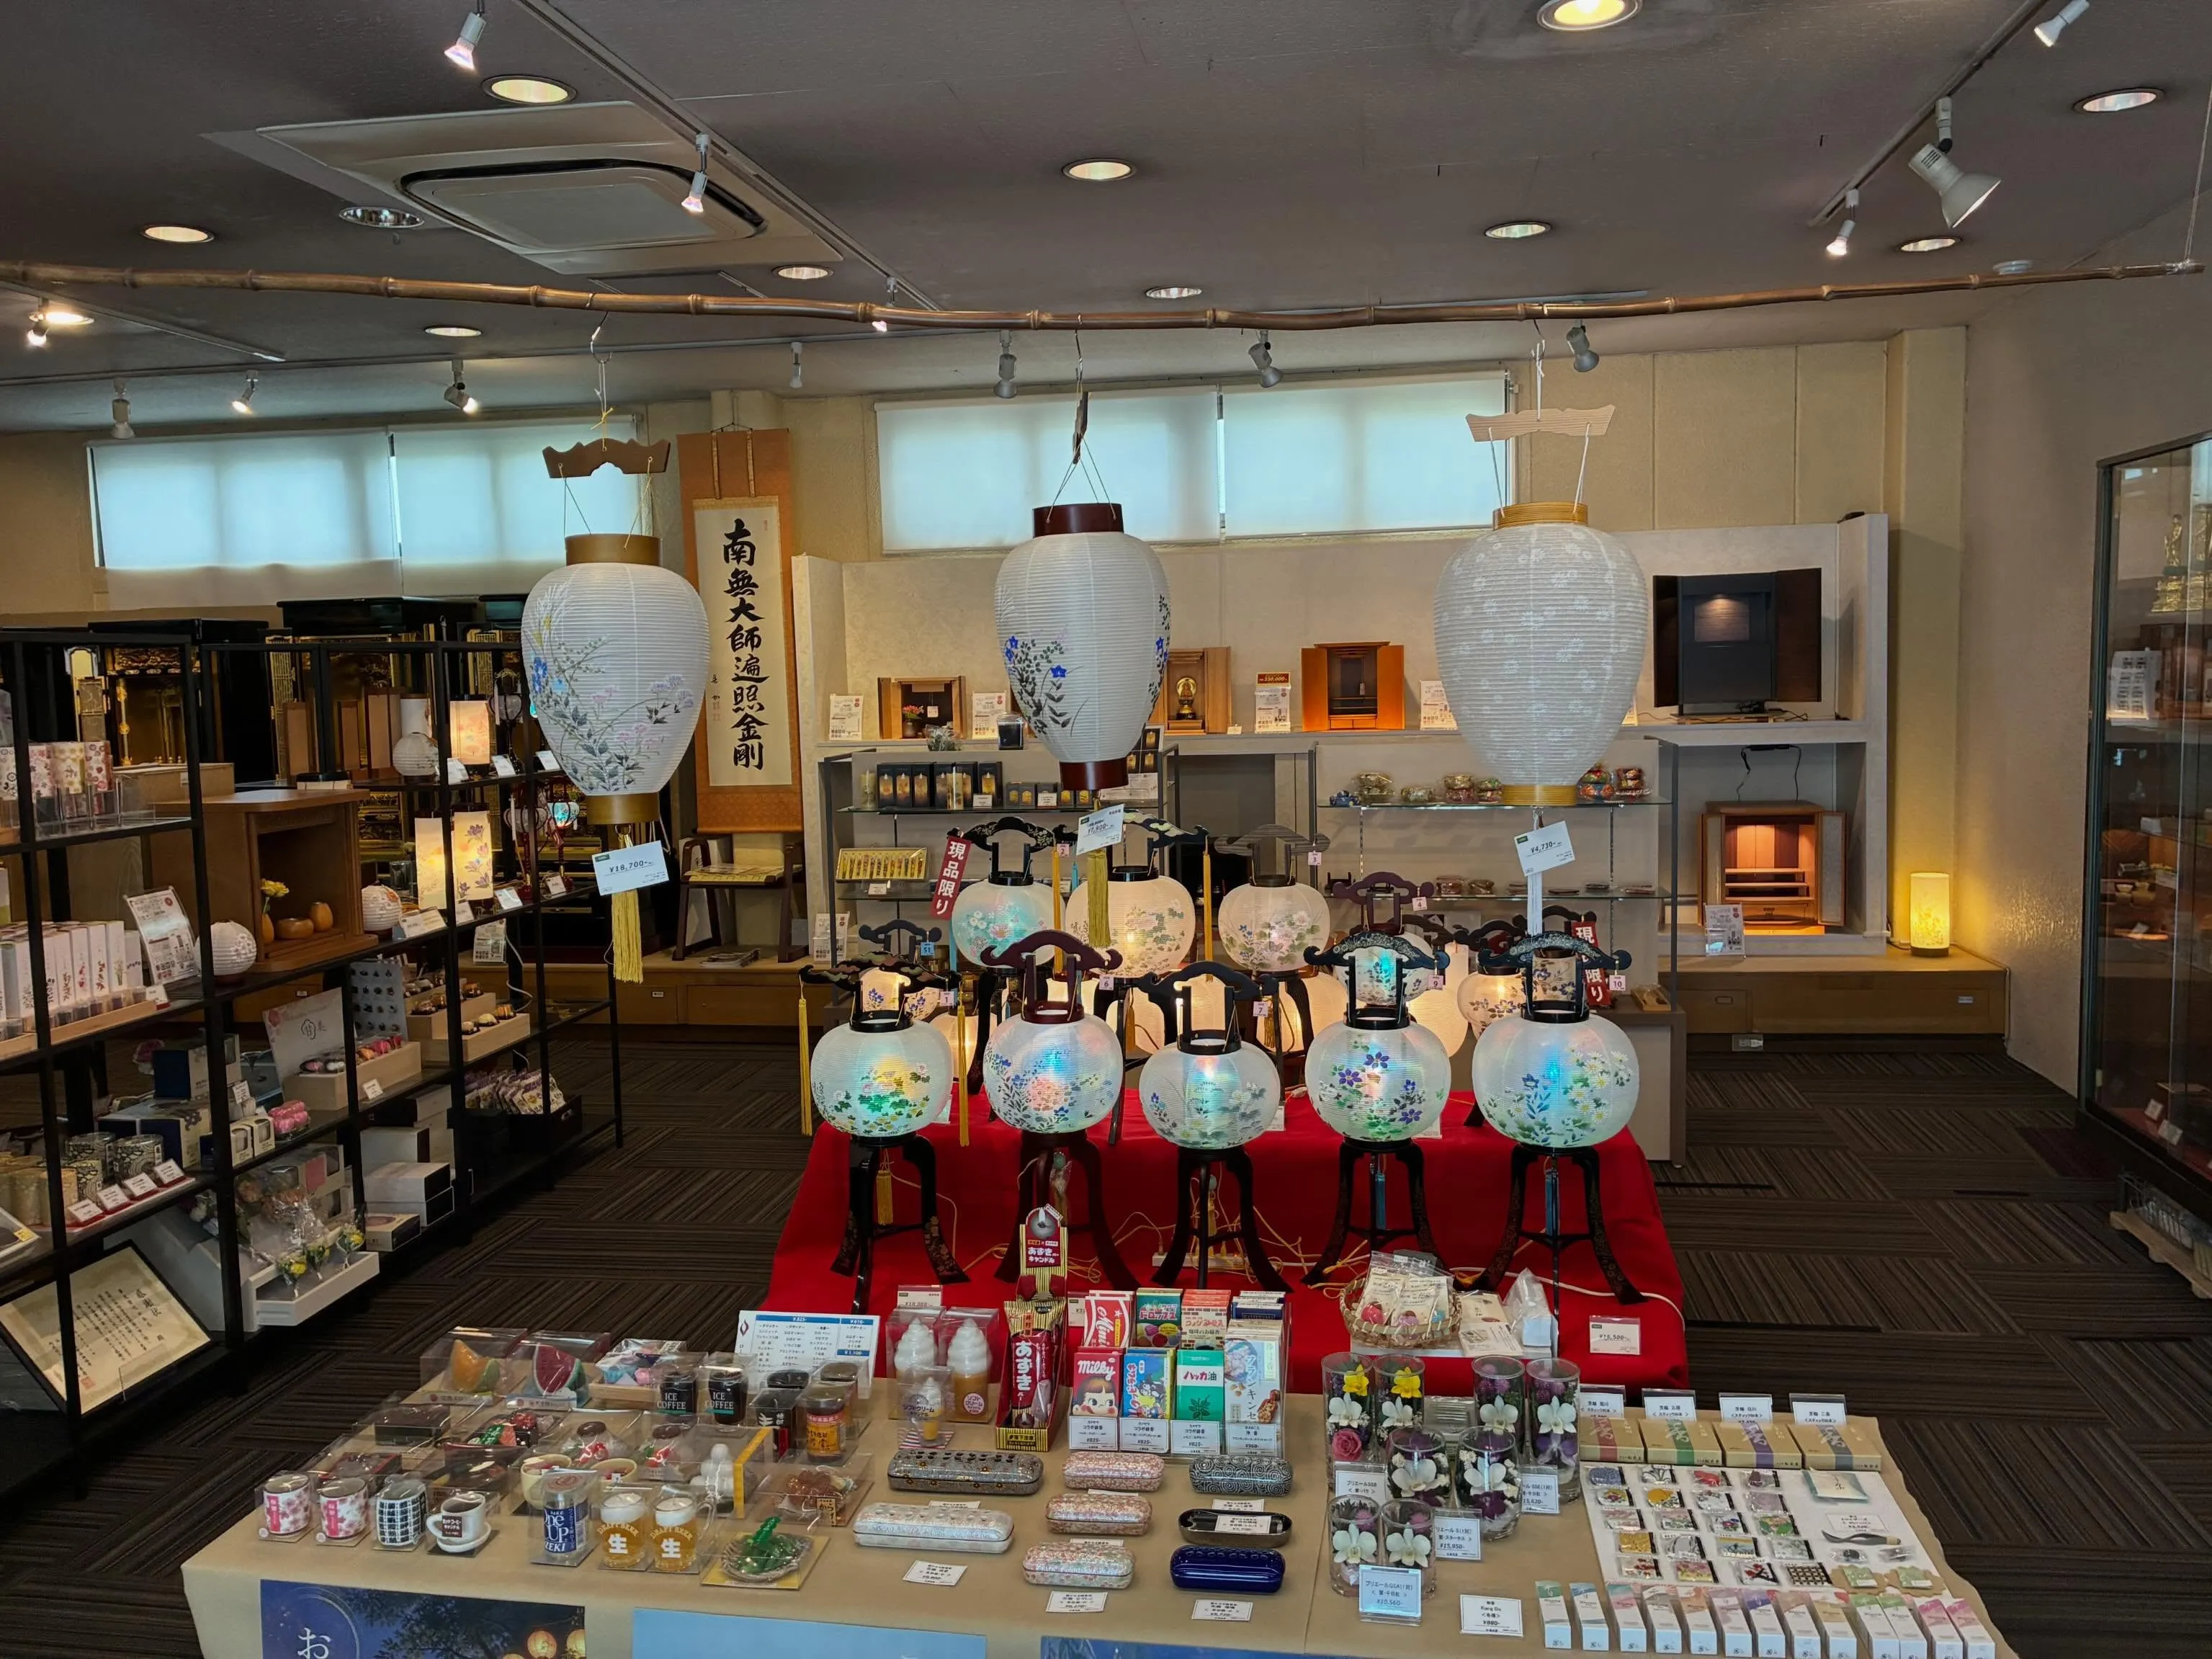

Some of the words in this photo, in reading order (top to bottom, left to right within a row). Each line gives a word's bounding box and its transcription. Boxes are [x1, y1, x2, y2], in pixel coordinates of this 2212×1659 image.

[723, 518, 771, 771] 南無大師遍照金剛
[1531, 841, 1556, 854] ¥4,730-
[609, 860, 648, 873] ¥18,700-
[936, 841, 967, 915] 現品限り
[1575, 926, 1604, 1002] 現限り
[1078, 1360, 1116, 1381] Milky
[1183, 1371, 1217, 1382] ハッカ油
[665, 1392, 678, 1401] ICE
[712, 1391, 726, 1400] ICE
[657, 1400, 686, 1410] COFFEE
[705, 1400, 734, 1410] COFFEE
[547, 1525, 569, 1542] UP
[597, 1521, 621, 1535] DRAFT
[622, 1522, 640, 1537] BEER
[650, 1526, 672, 1539] DRAFT
[674, 1527, 693, 1540] BEER
[608, 1533, 628, 1554] 生
[661, 1537, 681, 1558] 生
[297, 1627, 331, 1659] お
